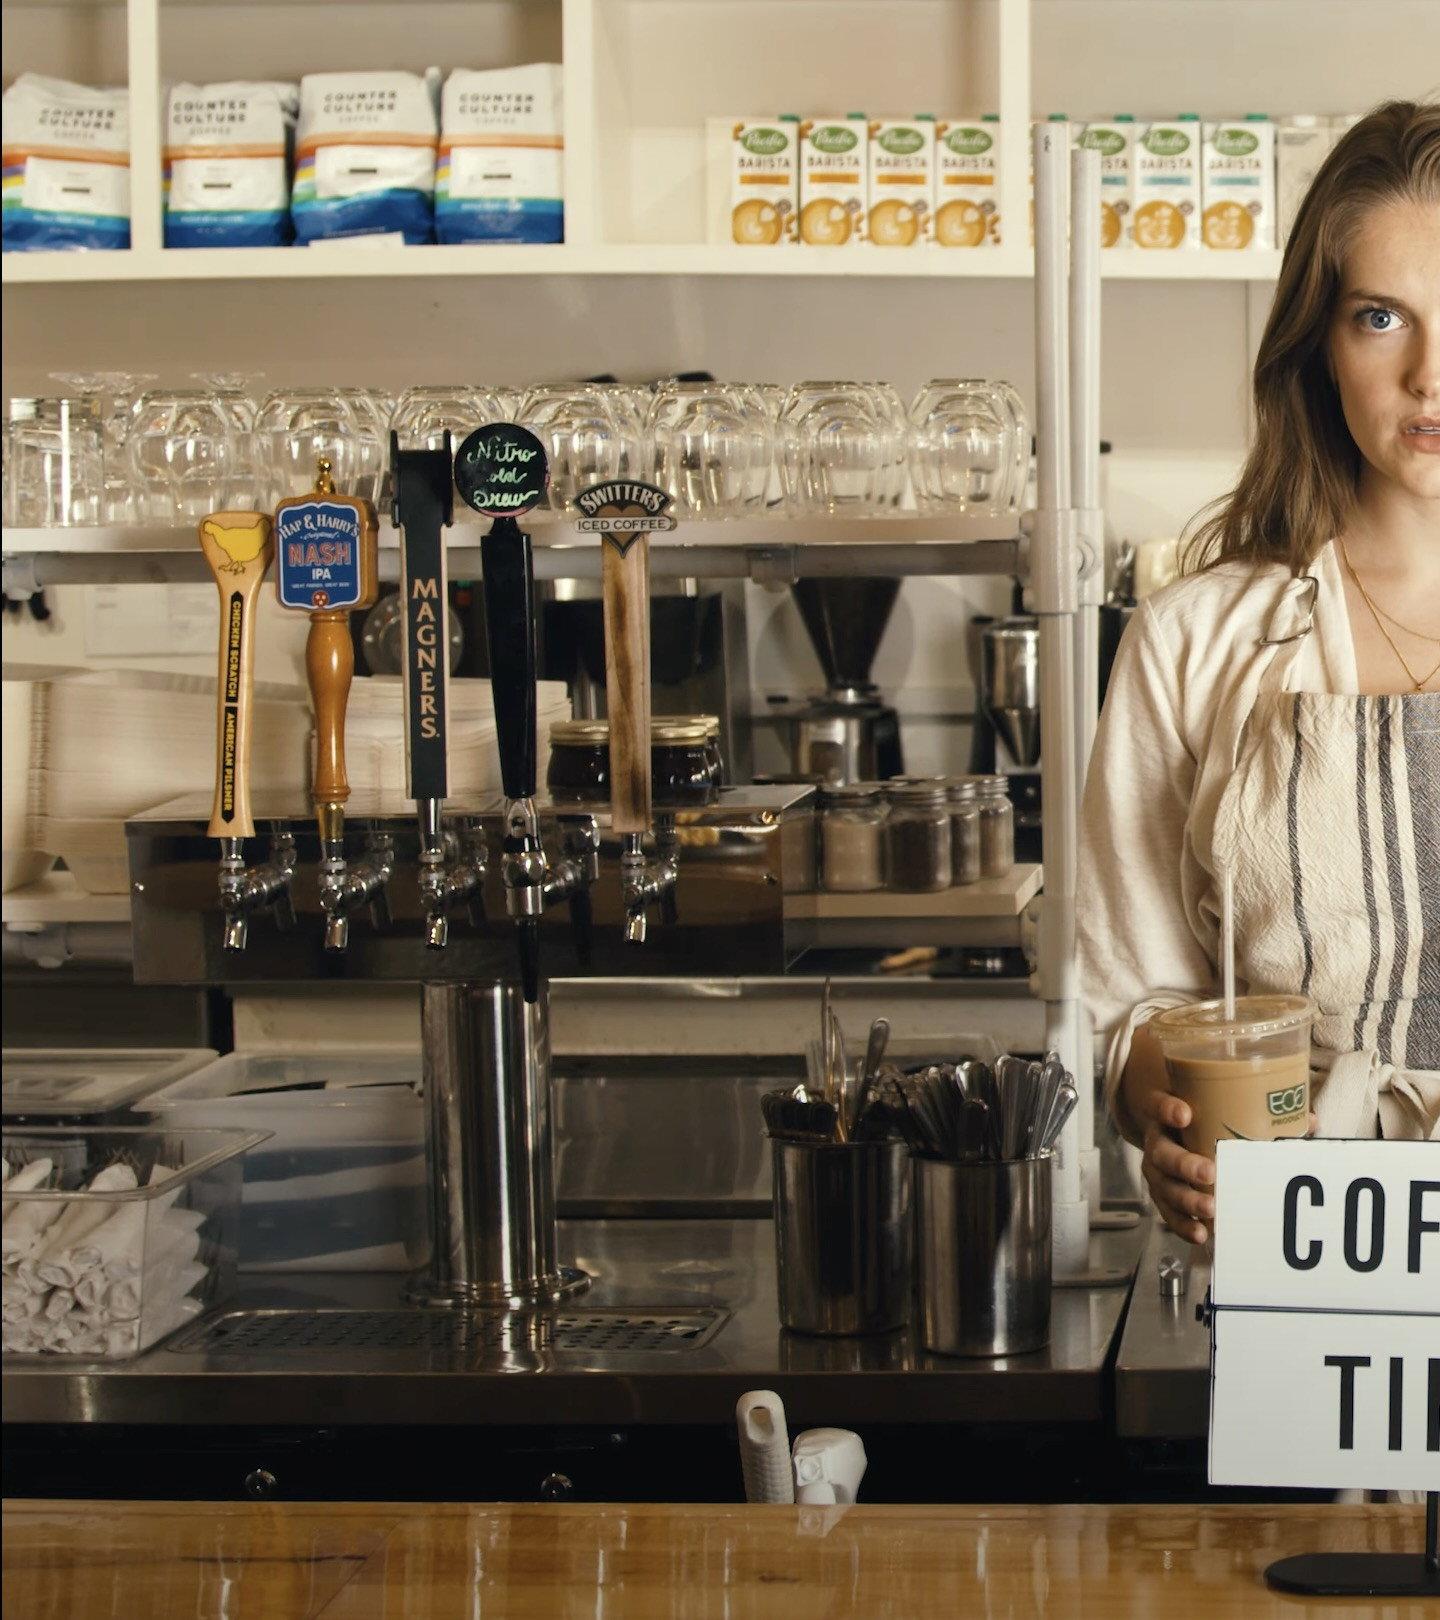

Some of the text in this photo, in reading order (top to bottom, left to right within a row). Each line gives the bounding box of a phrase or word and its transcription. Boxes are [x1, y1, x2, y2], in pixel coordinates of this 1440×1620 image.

[323, 91, 399, 102] COUNTER
[459, 93, 535, 103] COUNTER
[173, 100, 248, 112] COUNTER
[323, 103, 396, 114] CULTURE
[459, 104, 533, 114] CULTURE
[38, 116, 113, 130] CULTURE
[173, 113, 247, 124] CULTURE
[738, 157, 790, 168] BARISTA
[808, 156, 860, 167] BARISTA
[875, 157, 928, 168] BARISTA
[943, 157, 996, 168] BARISTA
[1101, 158, 1129, 169] ISTA
[1141, 158, 1192, 169] BARISTA
[467, 436, 537, 463] Nitro
[486, 467, 527, 484] old
[279, 520, 303, 539] HAP
[303, 514, 318, 531] &
[578, 519, 667, 531] ICED COFFEE
[288, 542, 352, 568] NASH
[311, 567, 332, 580] IPA
[228, 600, 242, 698] CHICKEN SCRATCH
[223, 713, 236, 811] AMERICAN PILSNER
